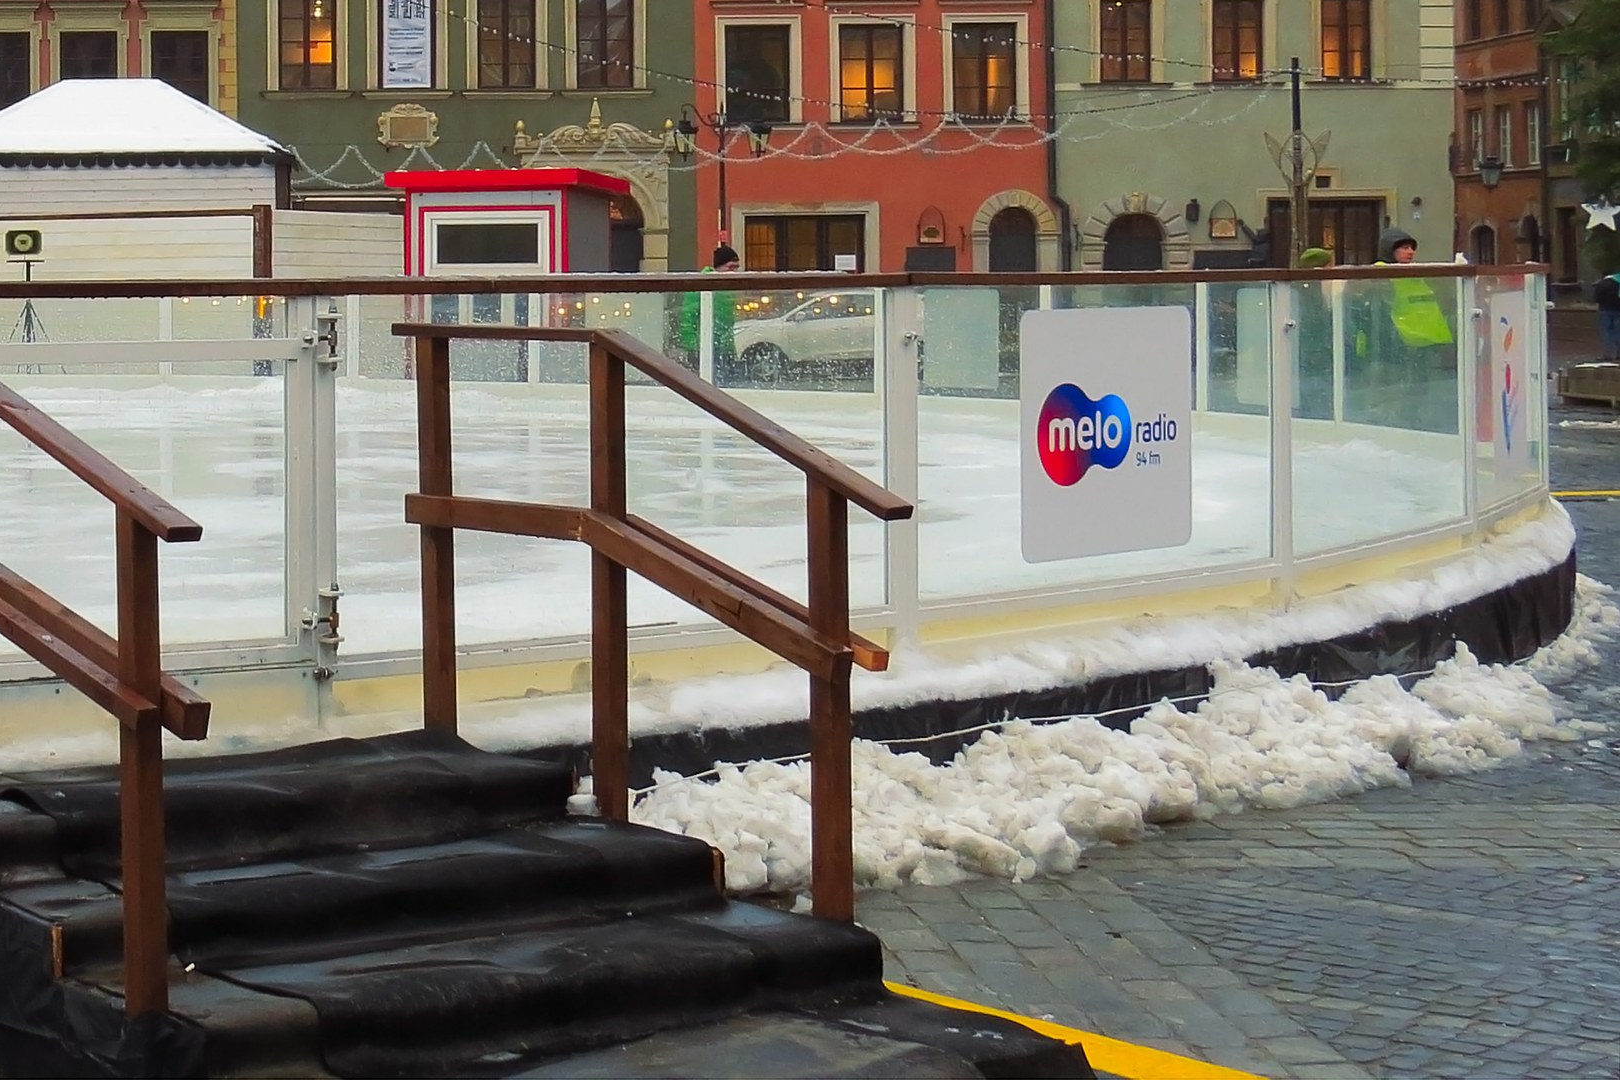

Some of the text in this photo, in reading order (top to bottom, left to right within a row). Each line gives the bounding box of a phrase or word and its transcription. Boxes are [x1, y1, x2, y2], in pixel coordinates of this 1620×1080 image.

[1049, 410, 1177, 452] melo radio
[1135, 451, 1161, 467] 94 fm
